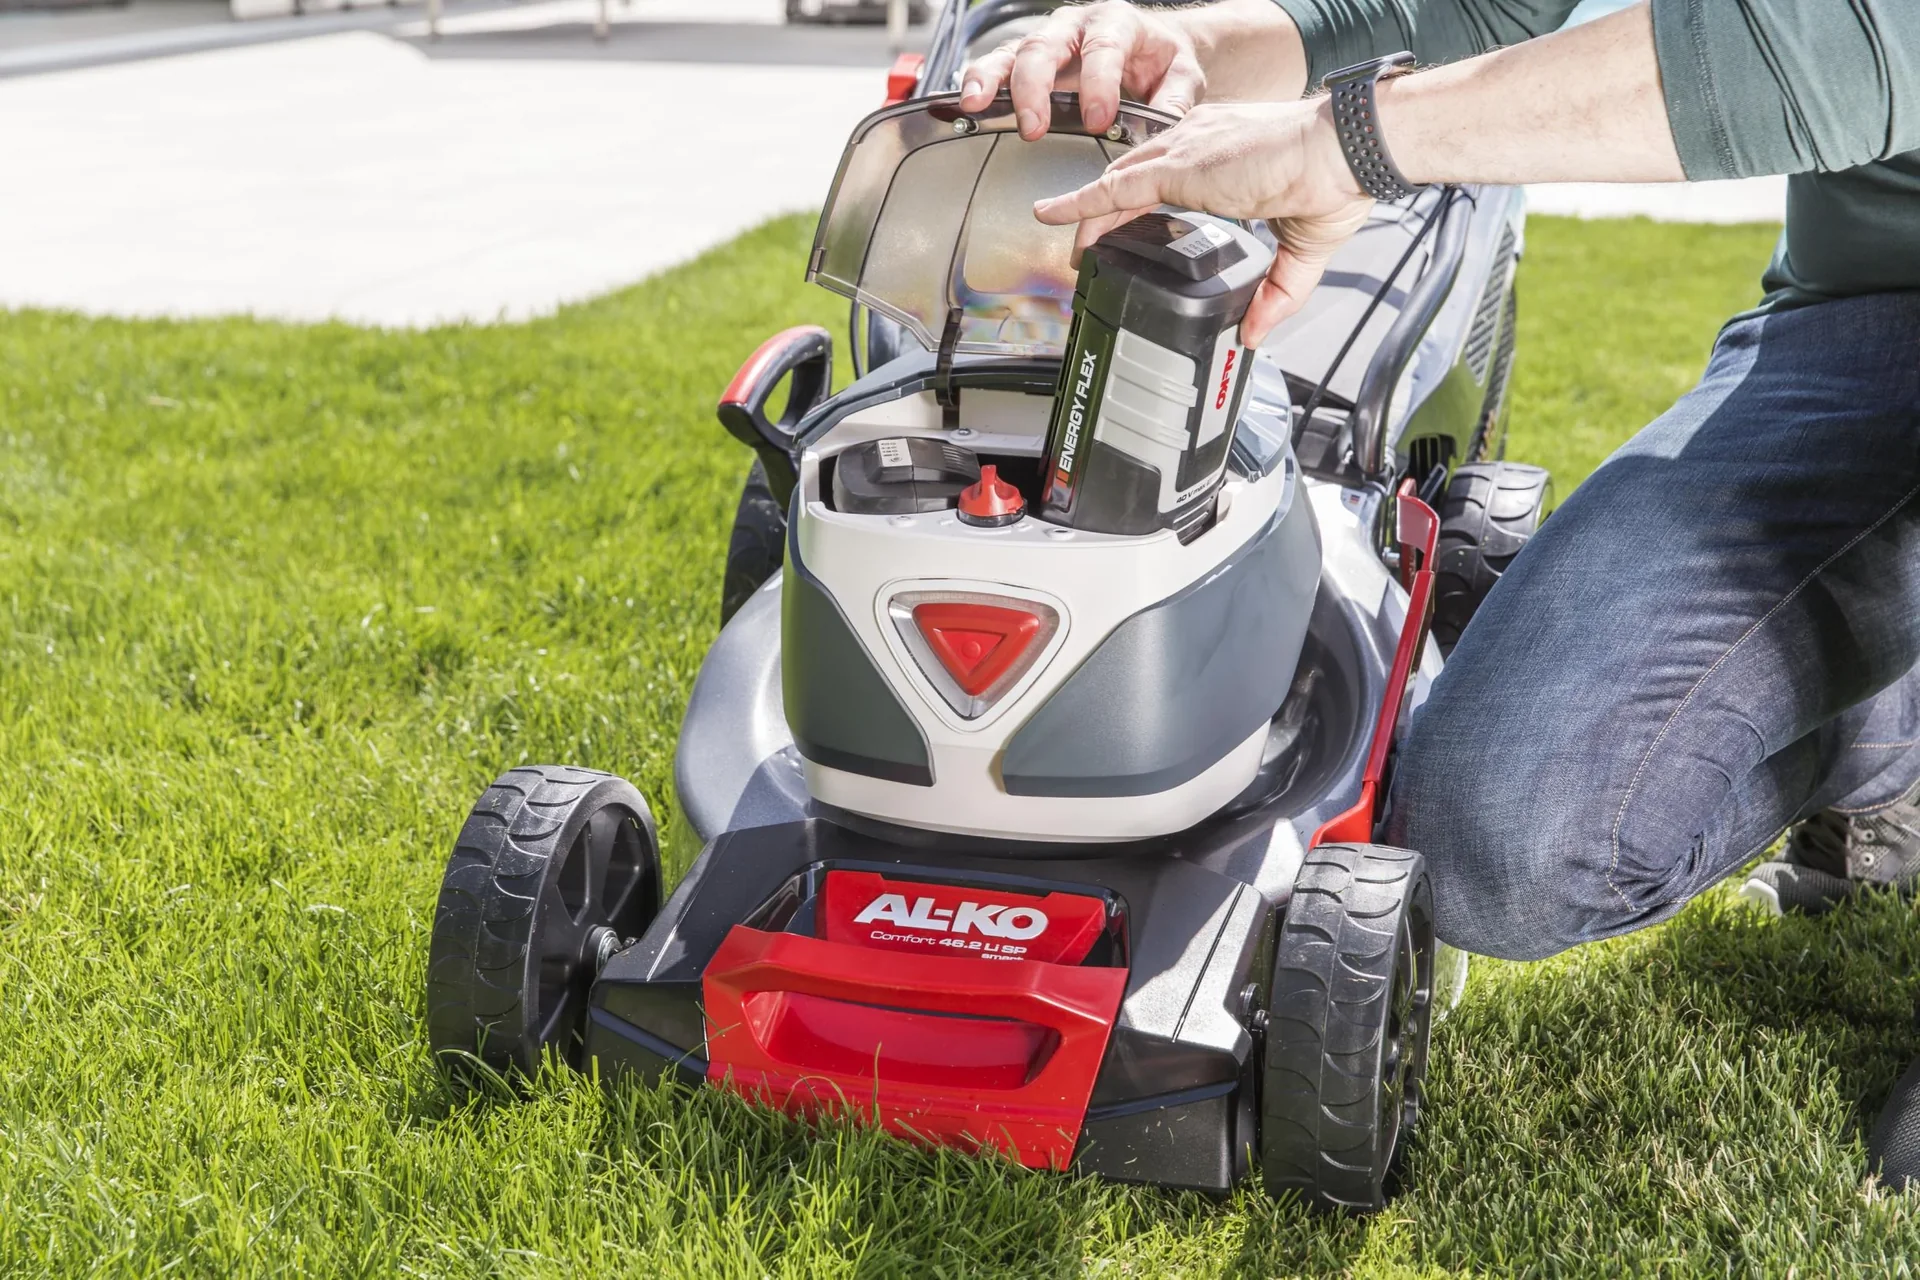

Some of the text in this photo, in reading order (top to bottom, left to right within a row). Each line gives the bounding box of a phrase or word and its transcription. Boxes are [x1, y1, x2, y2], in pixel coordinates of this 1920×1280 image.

[1215, 349, 1236, 410] AL-KO
[1058, 349, 1097, 473] ENERGY FLEX
[1176, 493, 1187, 503] 40
[853, 893, 1048, 940] AL-KO
[870, 930, 1027, 954] Comfort 46.2 Li SP
